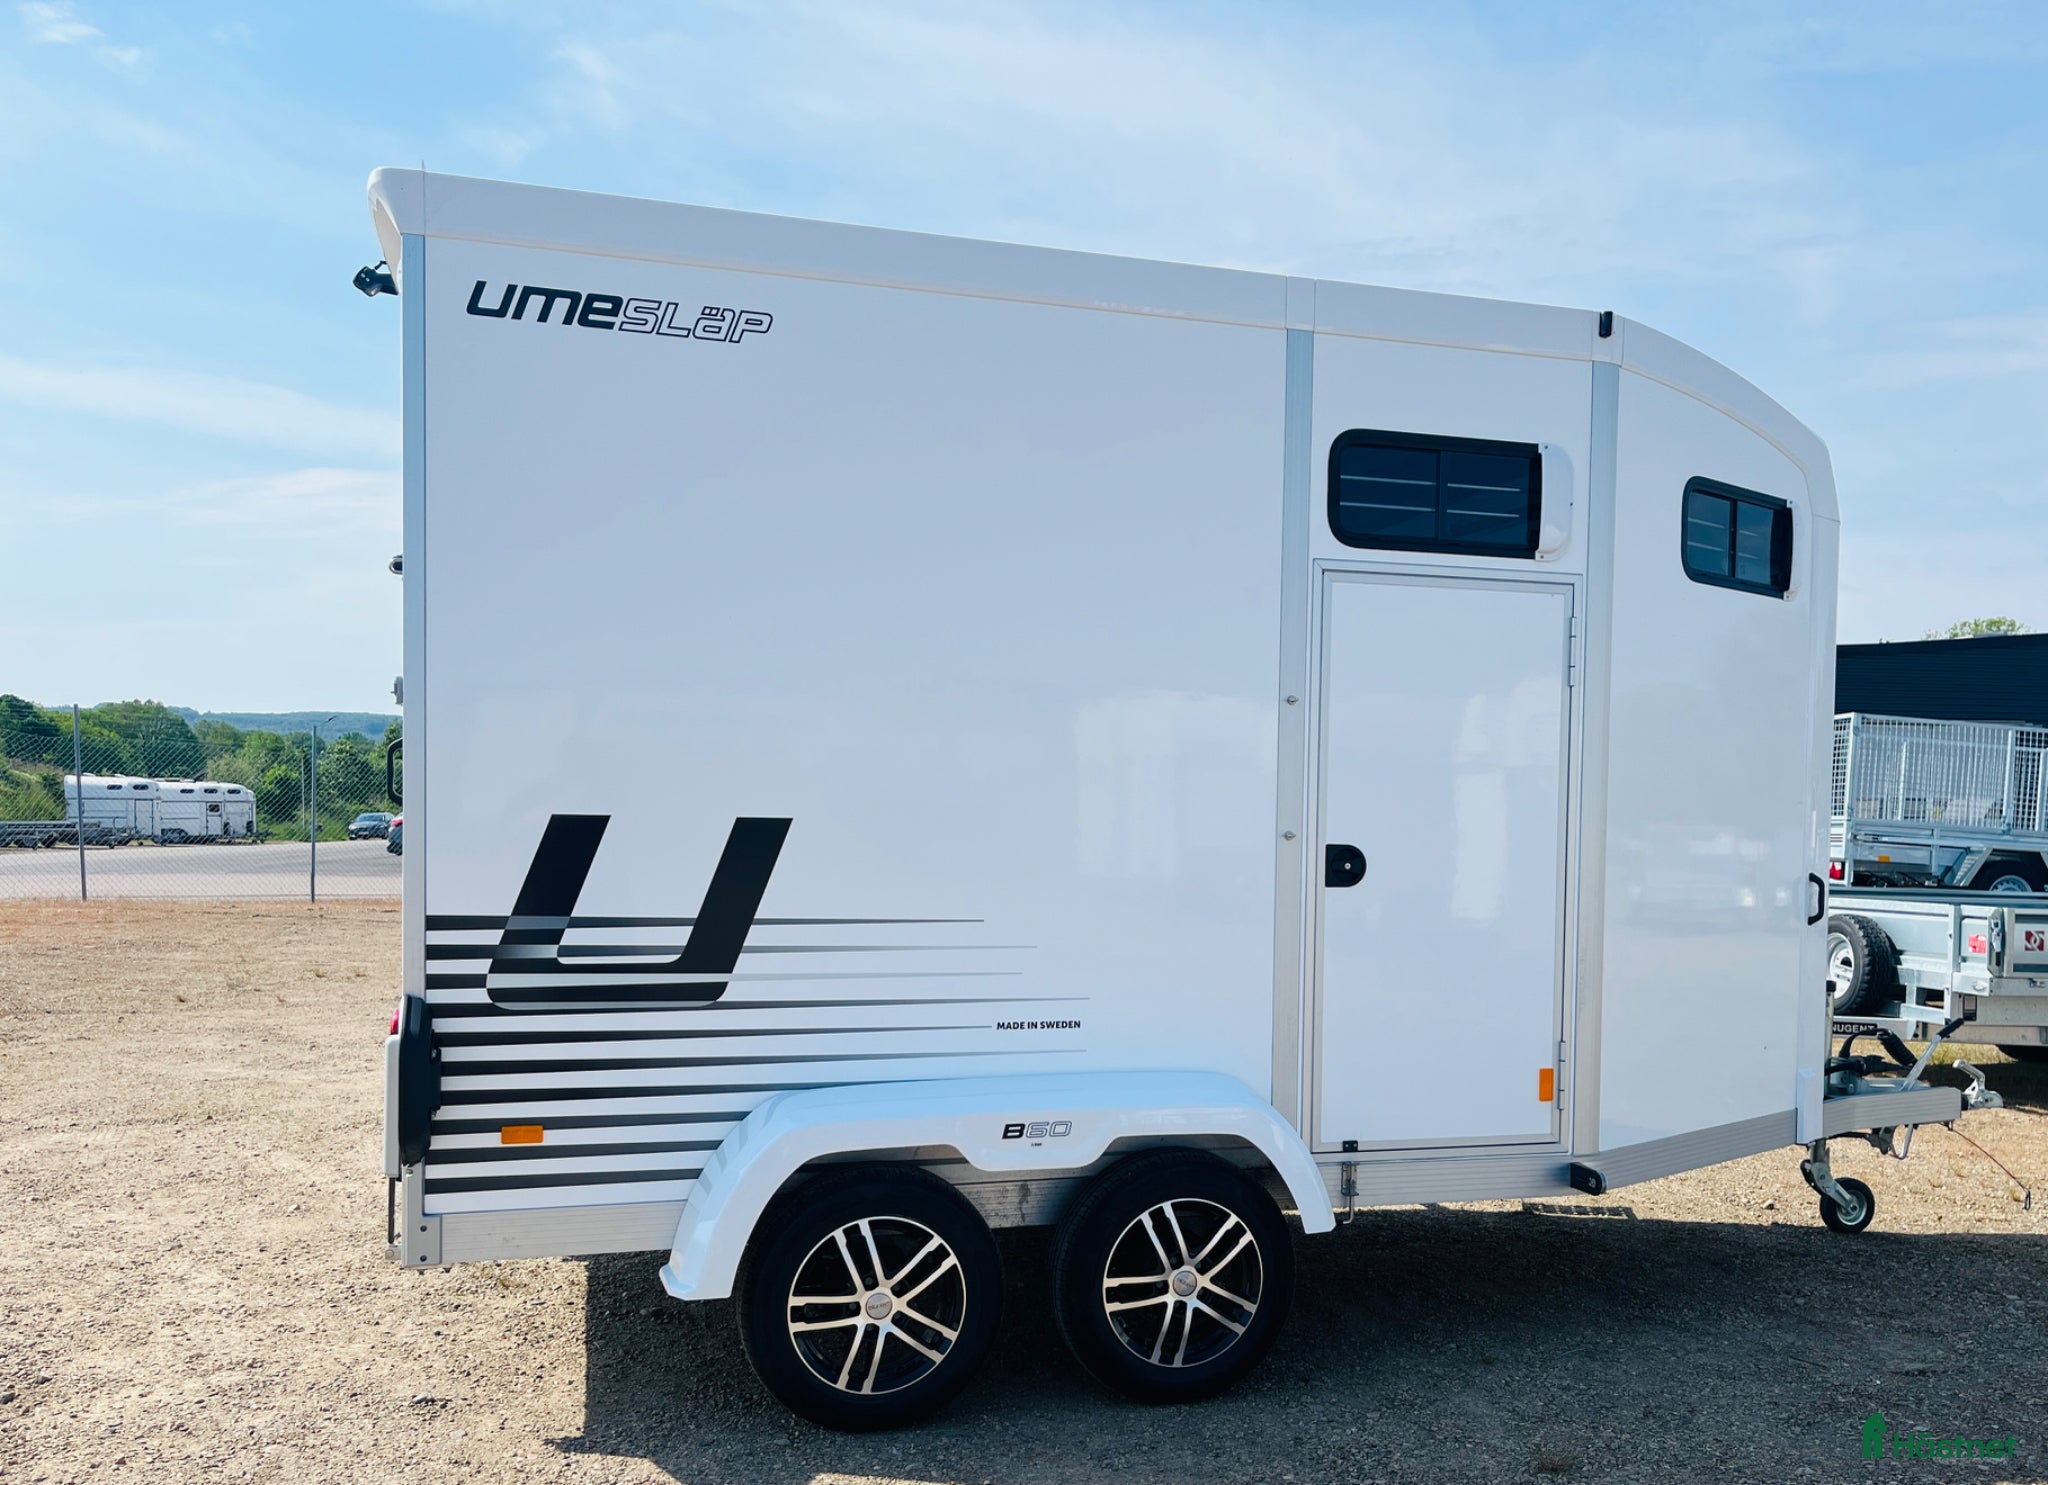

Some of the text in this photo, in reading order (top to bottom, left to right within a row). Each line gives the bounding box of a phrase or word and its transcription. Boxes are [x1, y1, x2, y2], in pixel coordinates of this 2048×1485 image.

[997, 1020, 1081, 1030] MADE IN SWEDEN
[1002, 1121, 1073, 1139] B60
